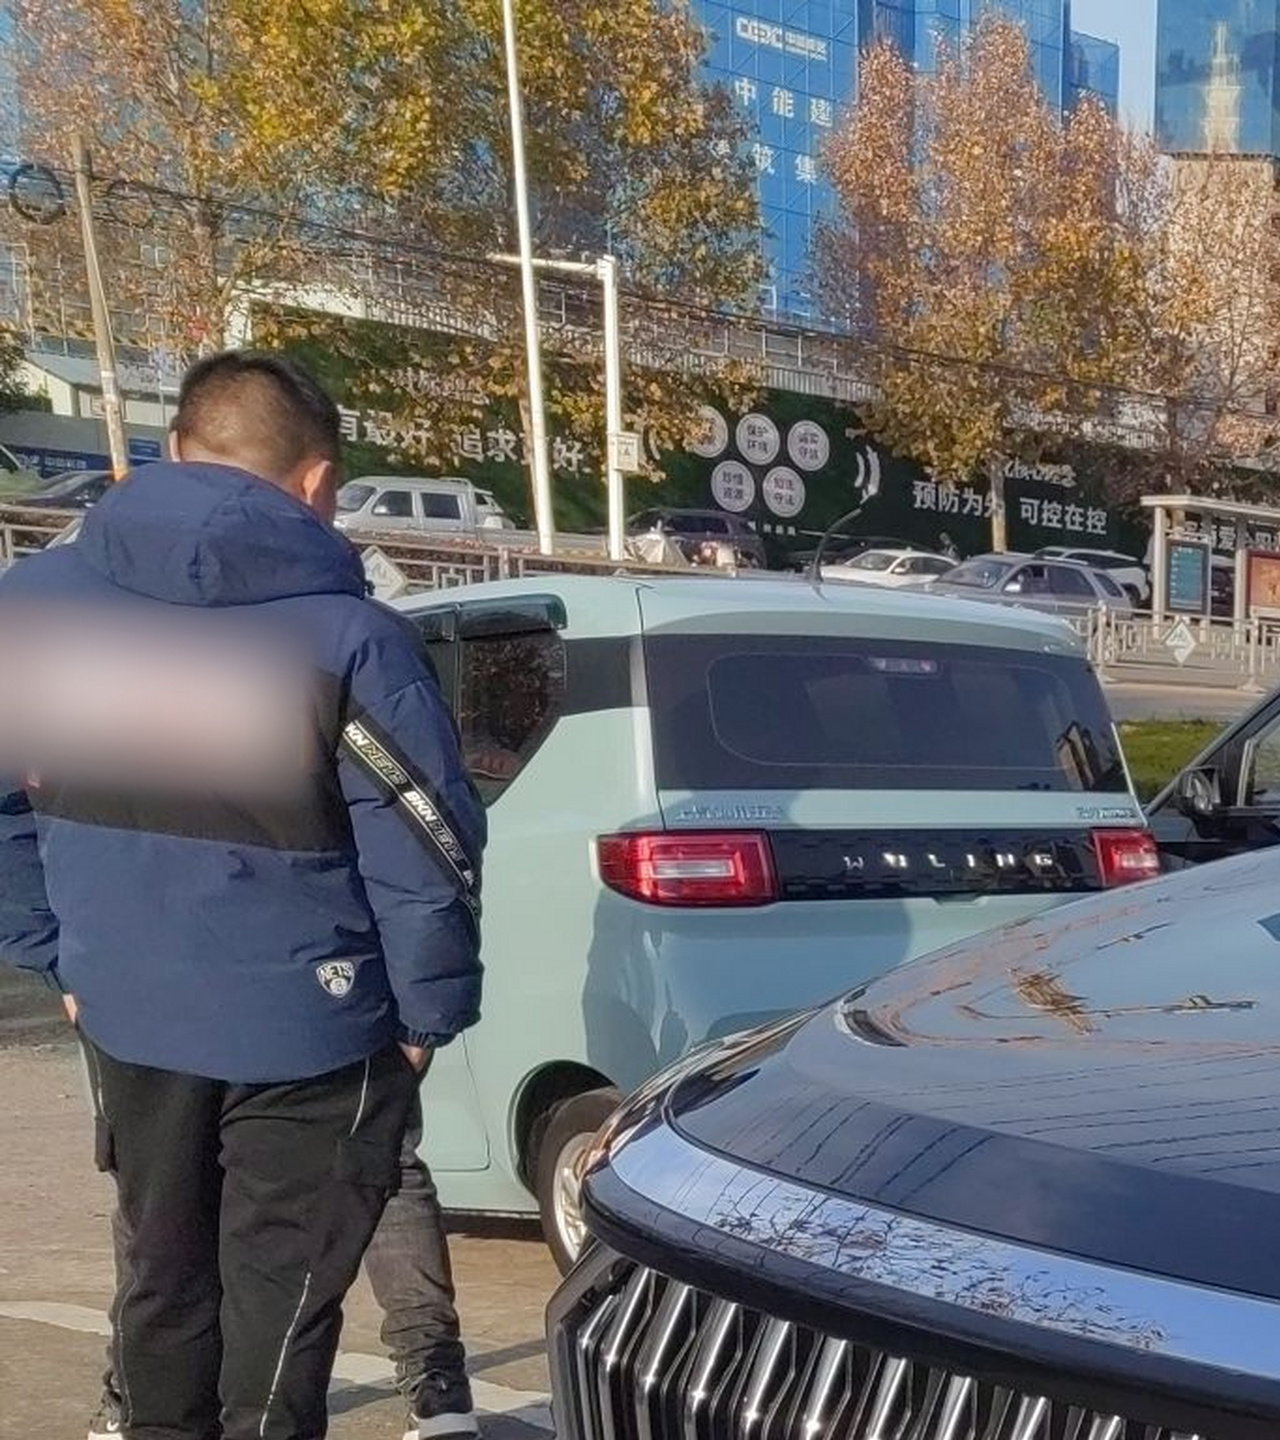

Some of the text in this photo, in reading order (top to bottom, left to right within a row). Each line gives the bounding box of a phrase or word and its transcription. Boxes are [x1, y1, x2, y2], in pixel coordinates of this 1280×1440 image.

[450, 423, 584, 472] 追求好
[1019, 497, 1108, 535] 可控在控
[403, 790, 438, 822] BKN
